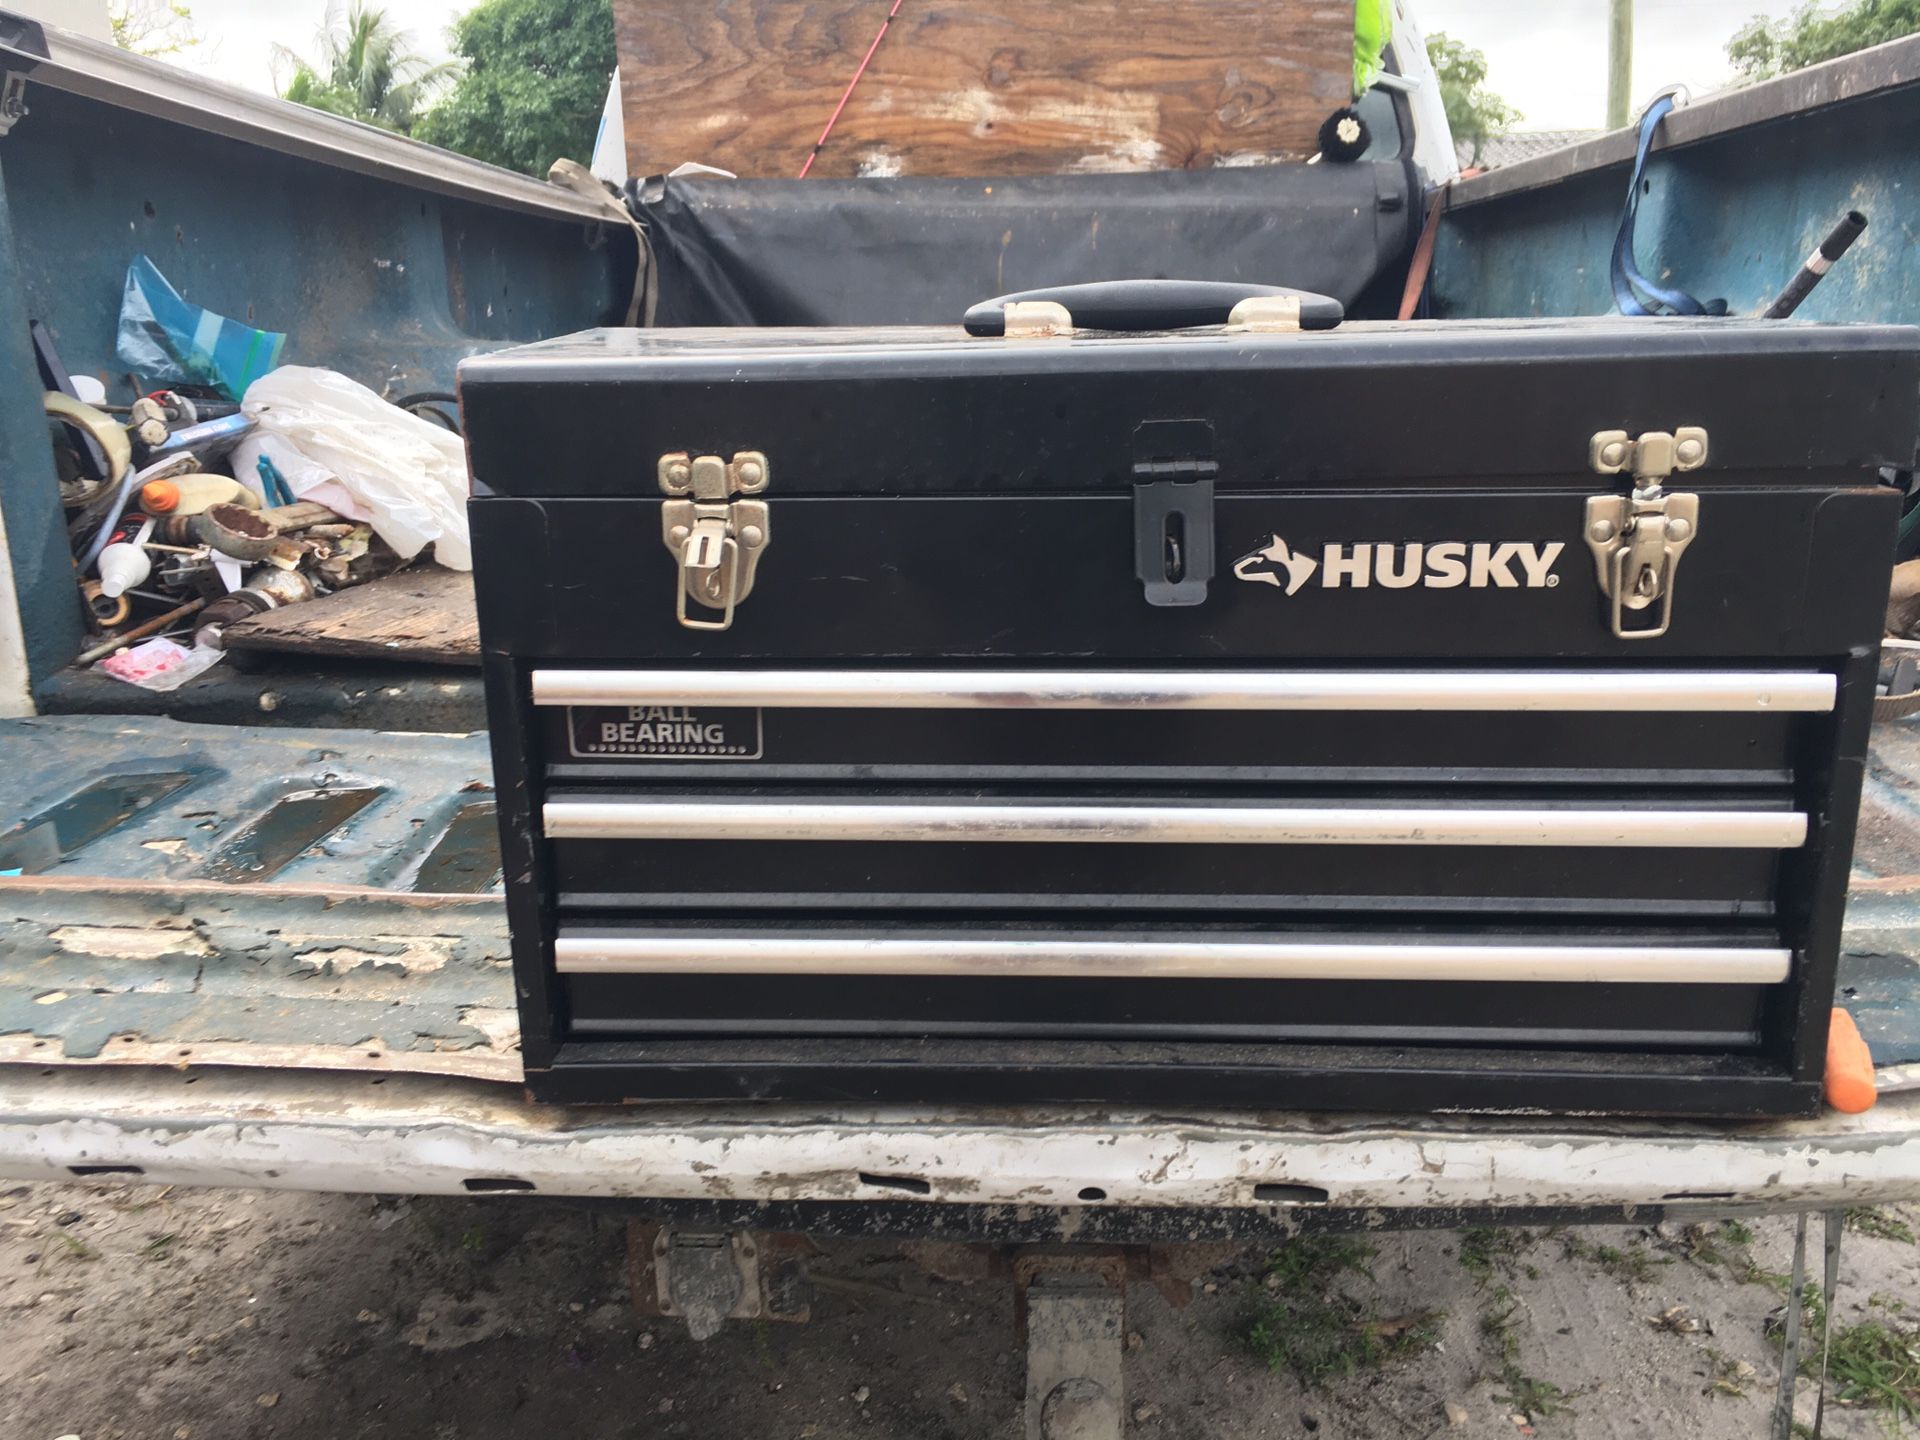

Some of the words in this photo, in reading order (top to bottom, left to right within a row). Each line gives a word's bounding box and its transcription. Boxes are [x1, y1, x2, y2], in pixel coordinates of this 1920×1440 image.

[1322, 542, 1565, 588] HUSKY
[628, 706, 697, 722] BALL
[601, 722, 725, 744] BEARING
